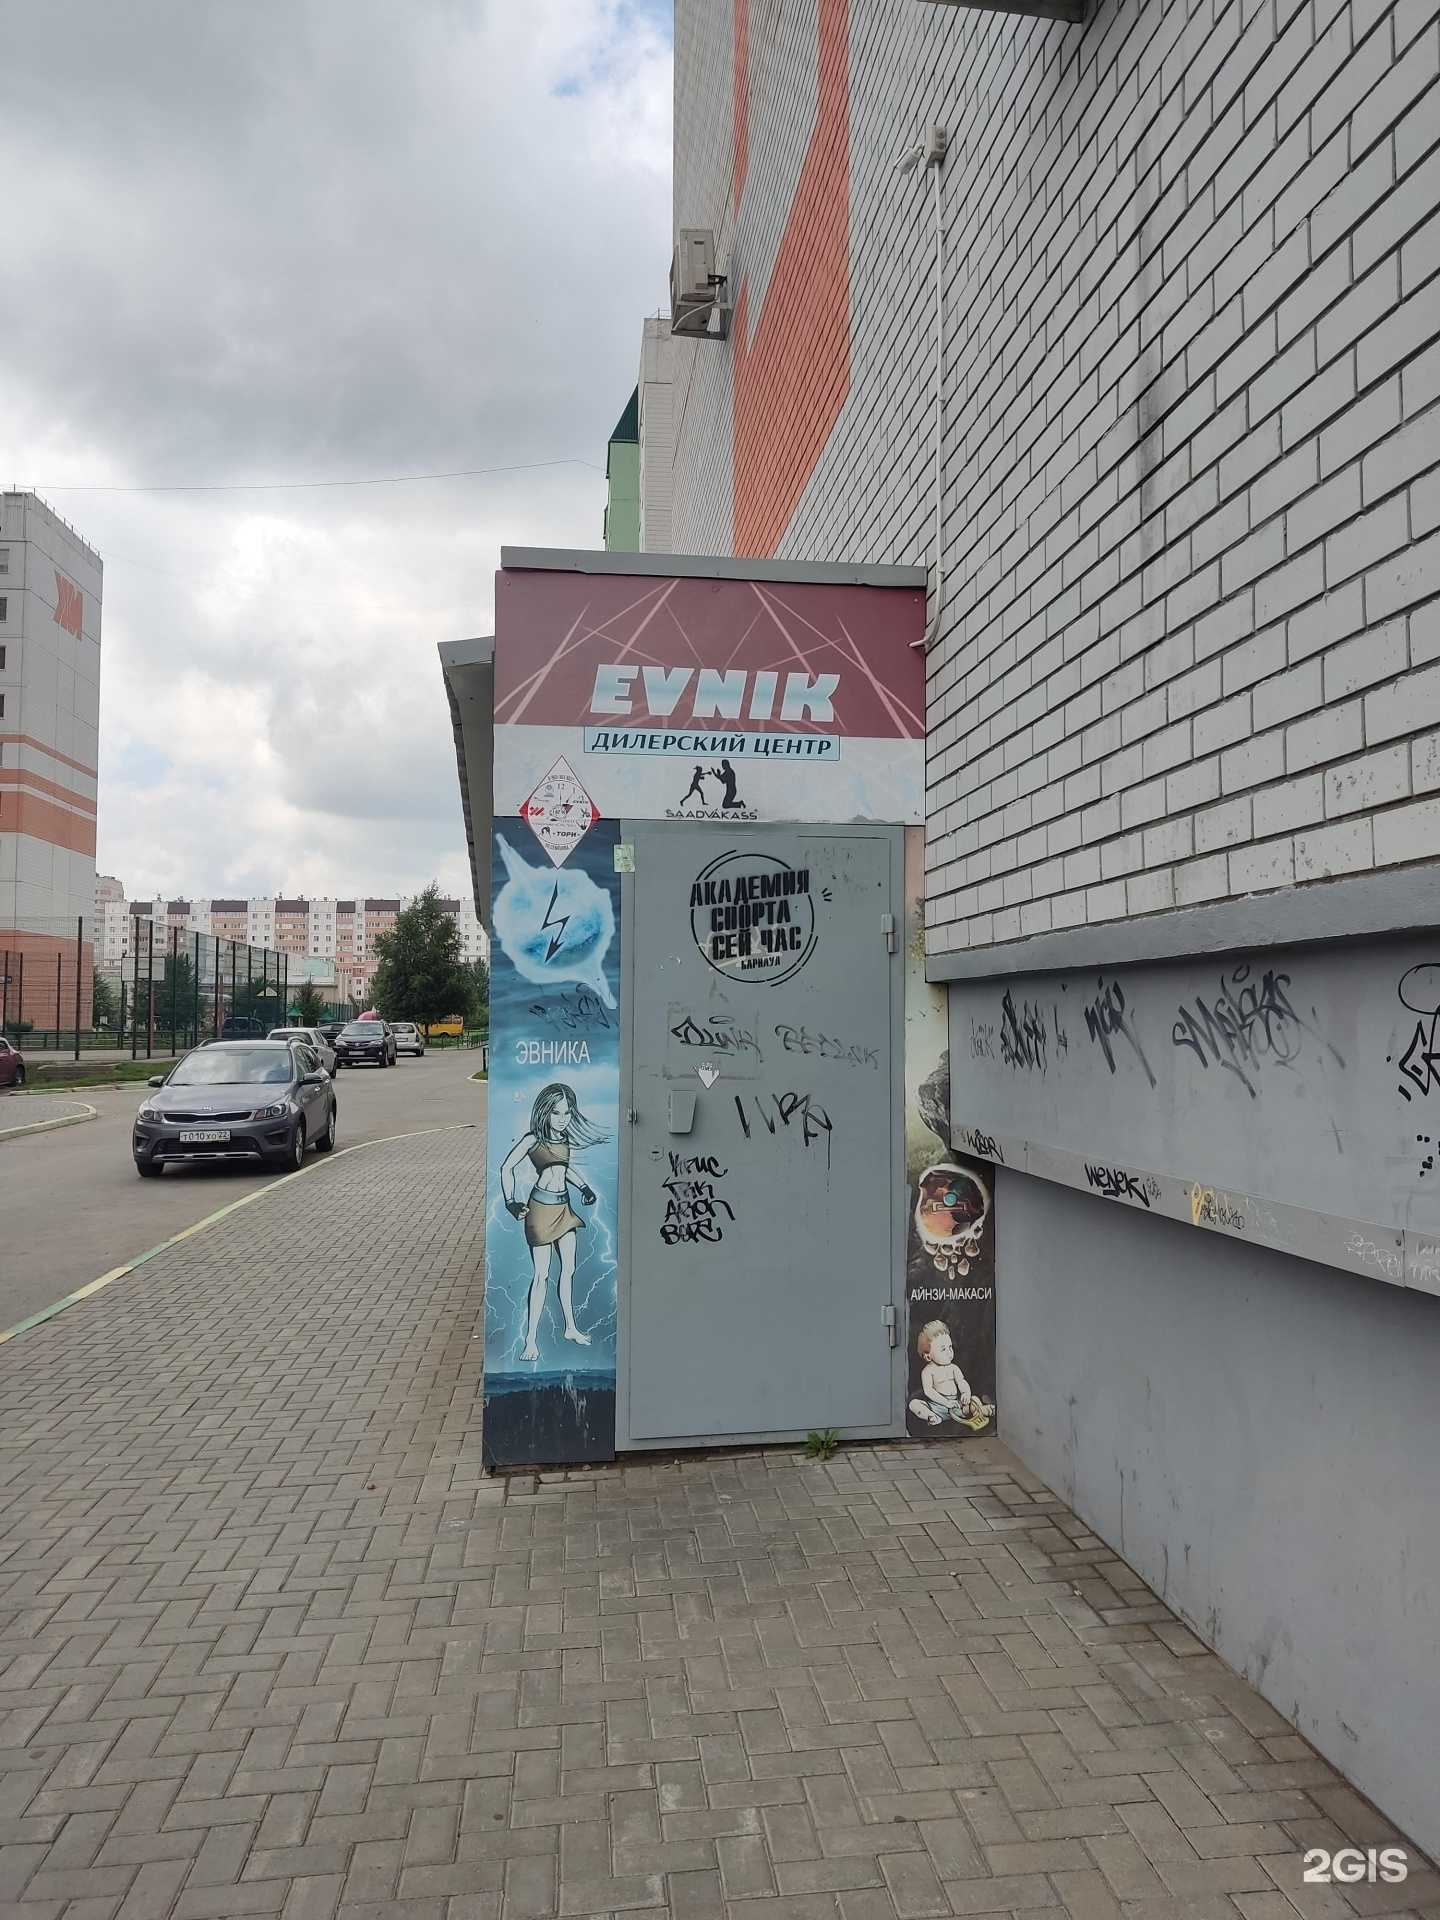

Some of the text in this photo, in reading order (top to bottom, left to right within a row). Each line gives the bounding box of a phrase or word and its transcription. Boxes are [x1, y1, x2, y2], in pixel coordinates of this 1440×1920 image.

[589, 664, 841, 723] EVNIK
[592, 732, 832, 756] ДИЛЕРСКИЙ ЦЕНТР
[689, 869, 810, 907] АКАДЕМИЯ
[710, 899, 791, 932] СПОРТА
[515, 1040, 591, 1065] ЭВНИКА
[910, 1285, 992, 1301] АЙНЗИ-МАКАСИ
